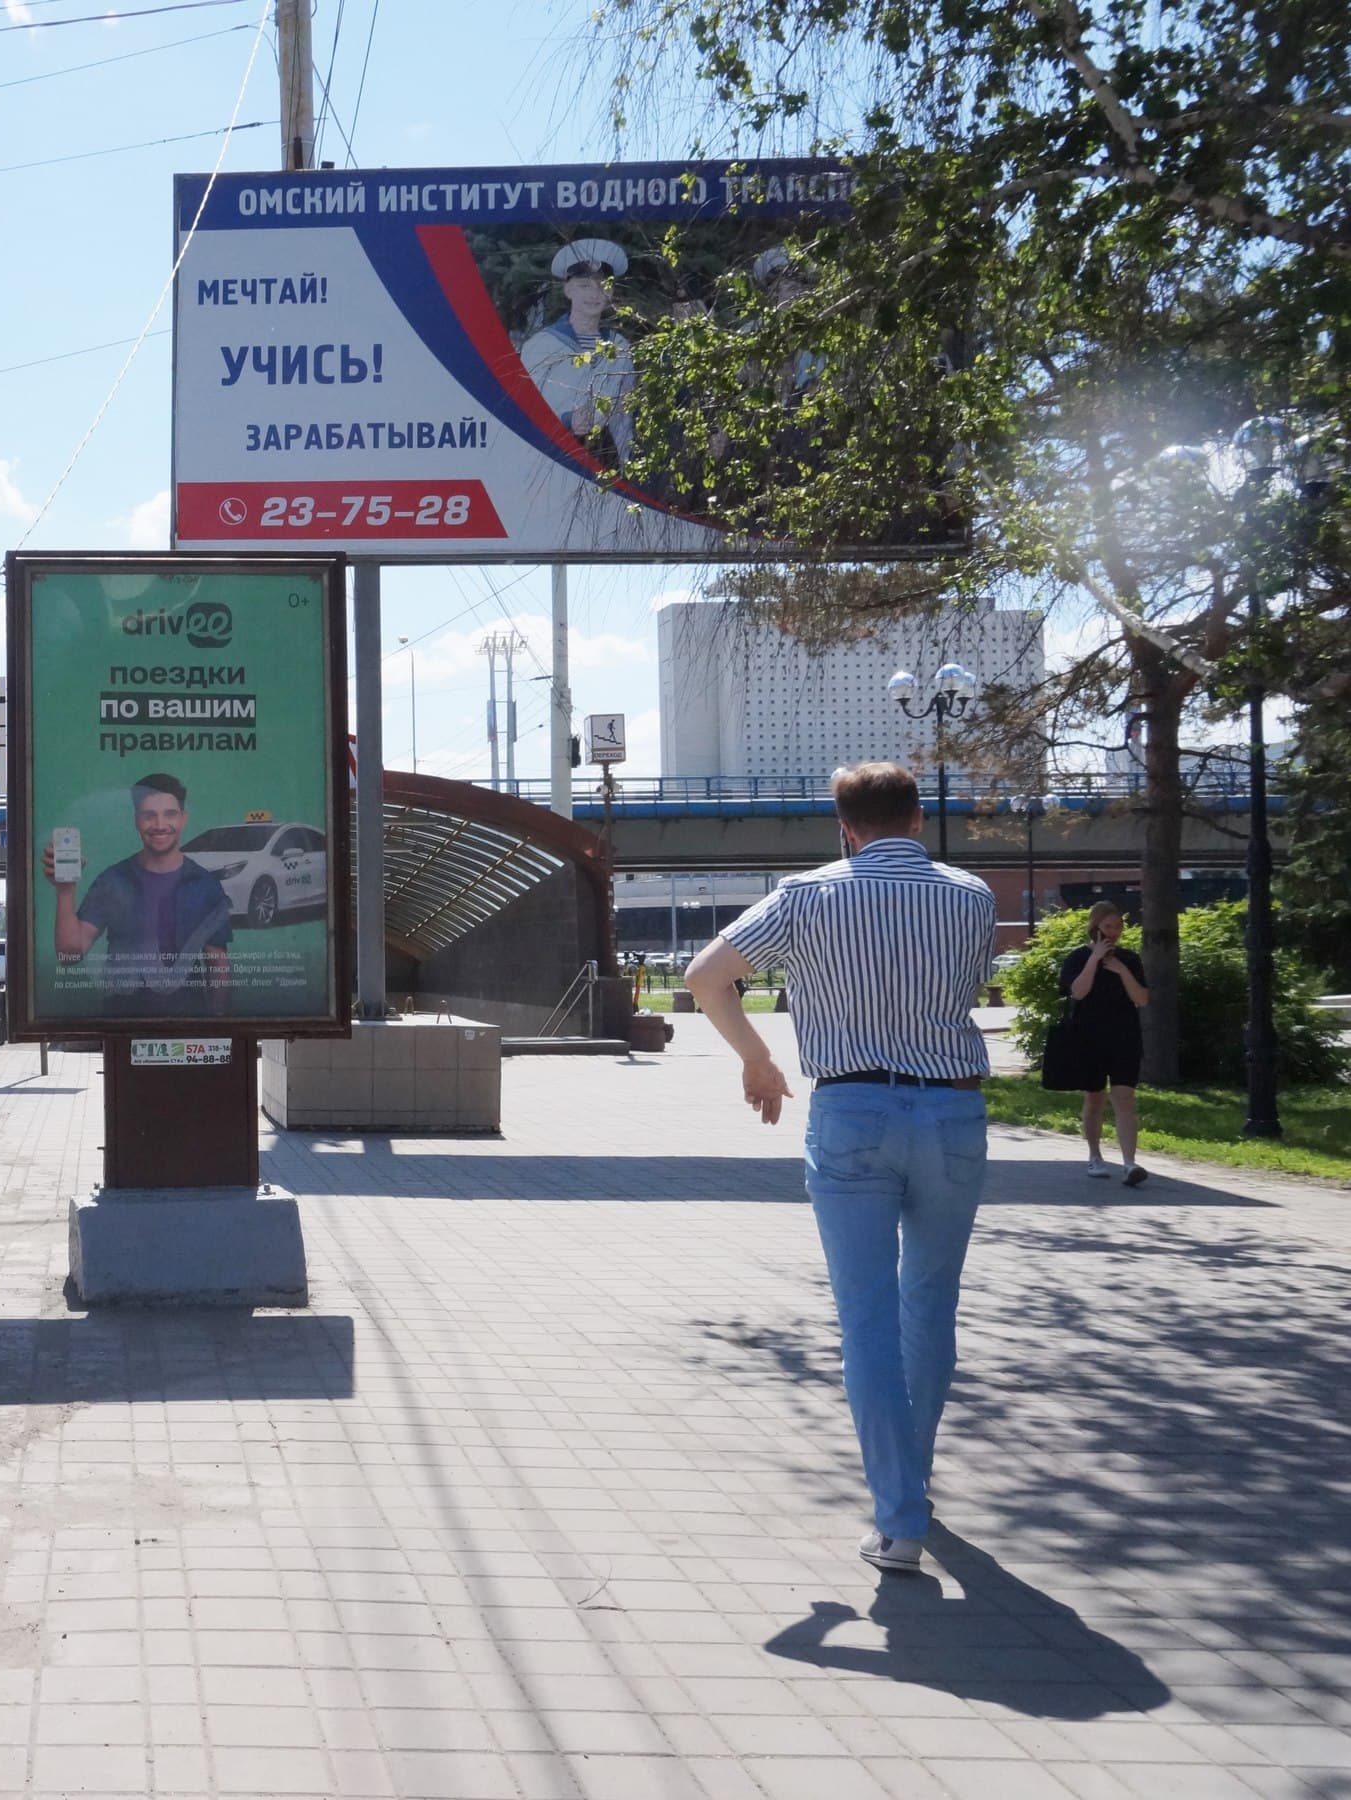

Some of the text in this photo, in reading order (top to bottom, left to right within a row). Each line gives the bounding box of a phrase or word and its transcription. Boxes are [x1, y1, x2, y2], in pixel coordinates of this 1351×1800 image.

[239, 180, 366, 215] ОМСКИЙ
[378, 181, 545, 213] ИНСТИТУТ
[556, 175, 707, 212] ВОДНОГО
[198, 271, 329, 305] МЕЧТАЙ!
[220, 343, 383, 386] УЧИСЬ!
[246, 416, 488, 451] ЗАРАБАТЫВАЙ!
[260, 495, 472, 527] 23-75-28
[288, 592, 310, 609] 0+
[122, 602, 233, 648] drivee
[110, 665, 246, 689] поездки
[100, 699, 256, 719] по вашим
[99, 732, 257, 758] правилам
[186, 1055, 232, 1064] 94-88-88
